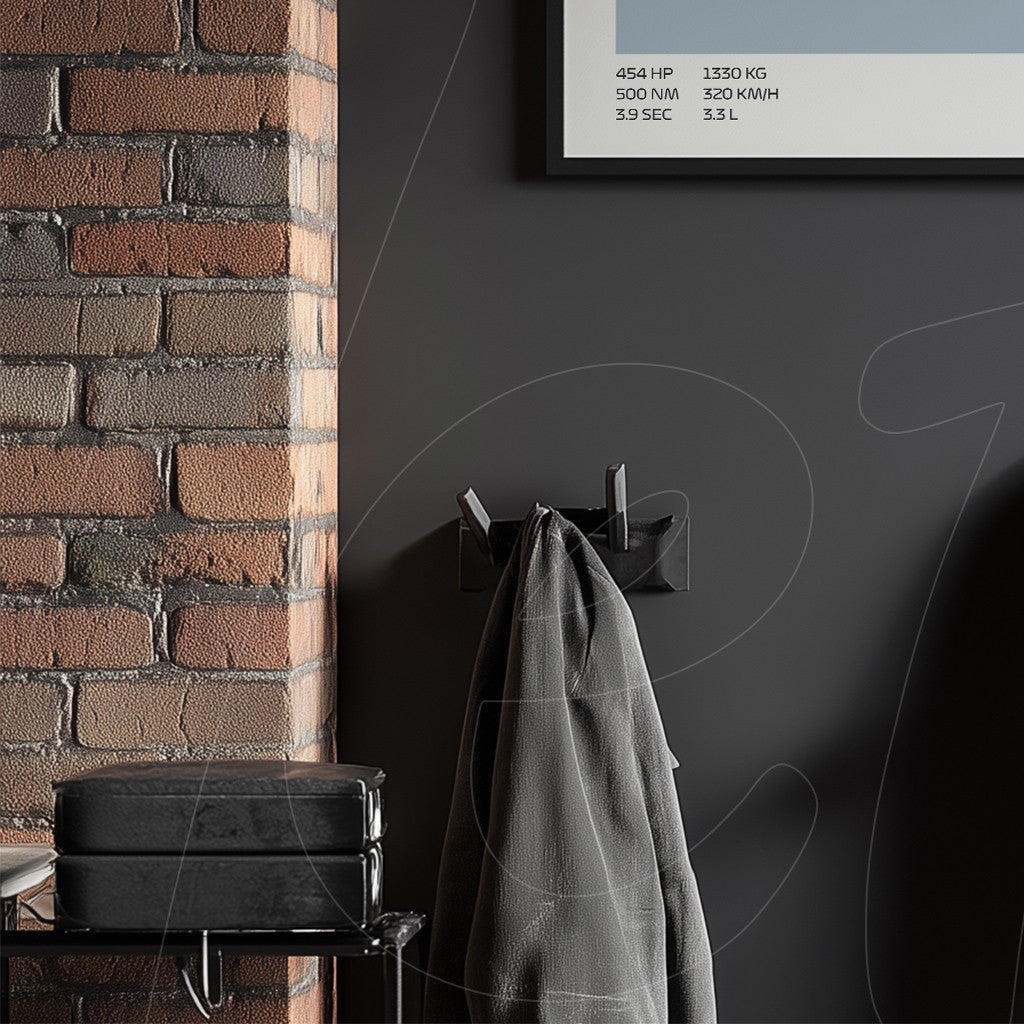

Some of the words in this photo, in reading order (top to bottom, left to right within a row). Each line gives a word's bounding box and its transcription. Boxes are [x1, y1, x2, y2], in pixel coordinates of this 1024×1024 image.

[615, 67, 647, 80] 454
[651, 67, 674, 80] HP
[703, 67, 742, 80] 1330
[745, 67, 767, 80] KG
[616, 87, 647, 101] 500
[651, 87, 679, 101] NM
[703, 87, 733, 101] 320
[737, 87, 779, 102] KM/H
[615, 108, 639, 121] 3.9
[641, 108, 672, 121] SEC
[703, 108, 726, 121] 3.3
[729, 108, 738, 121] L
